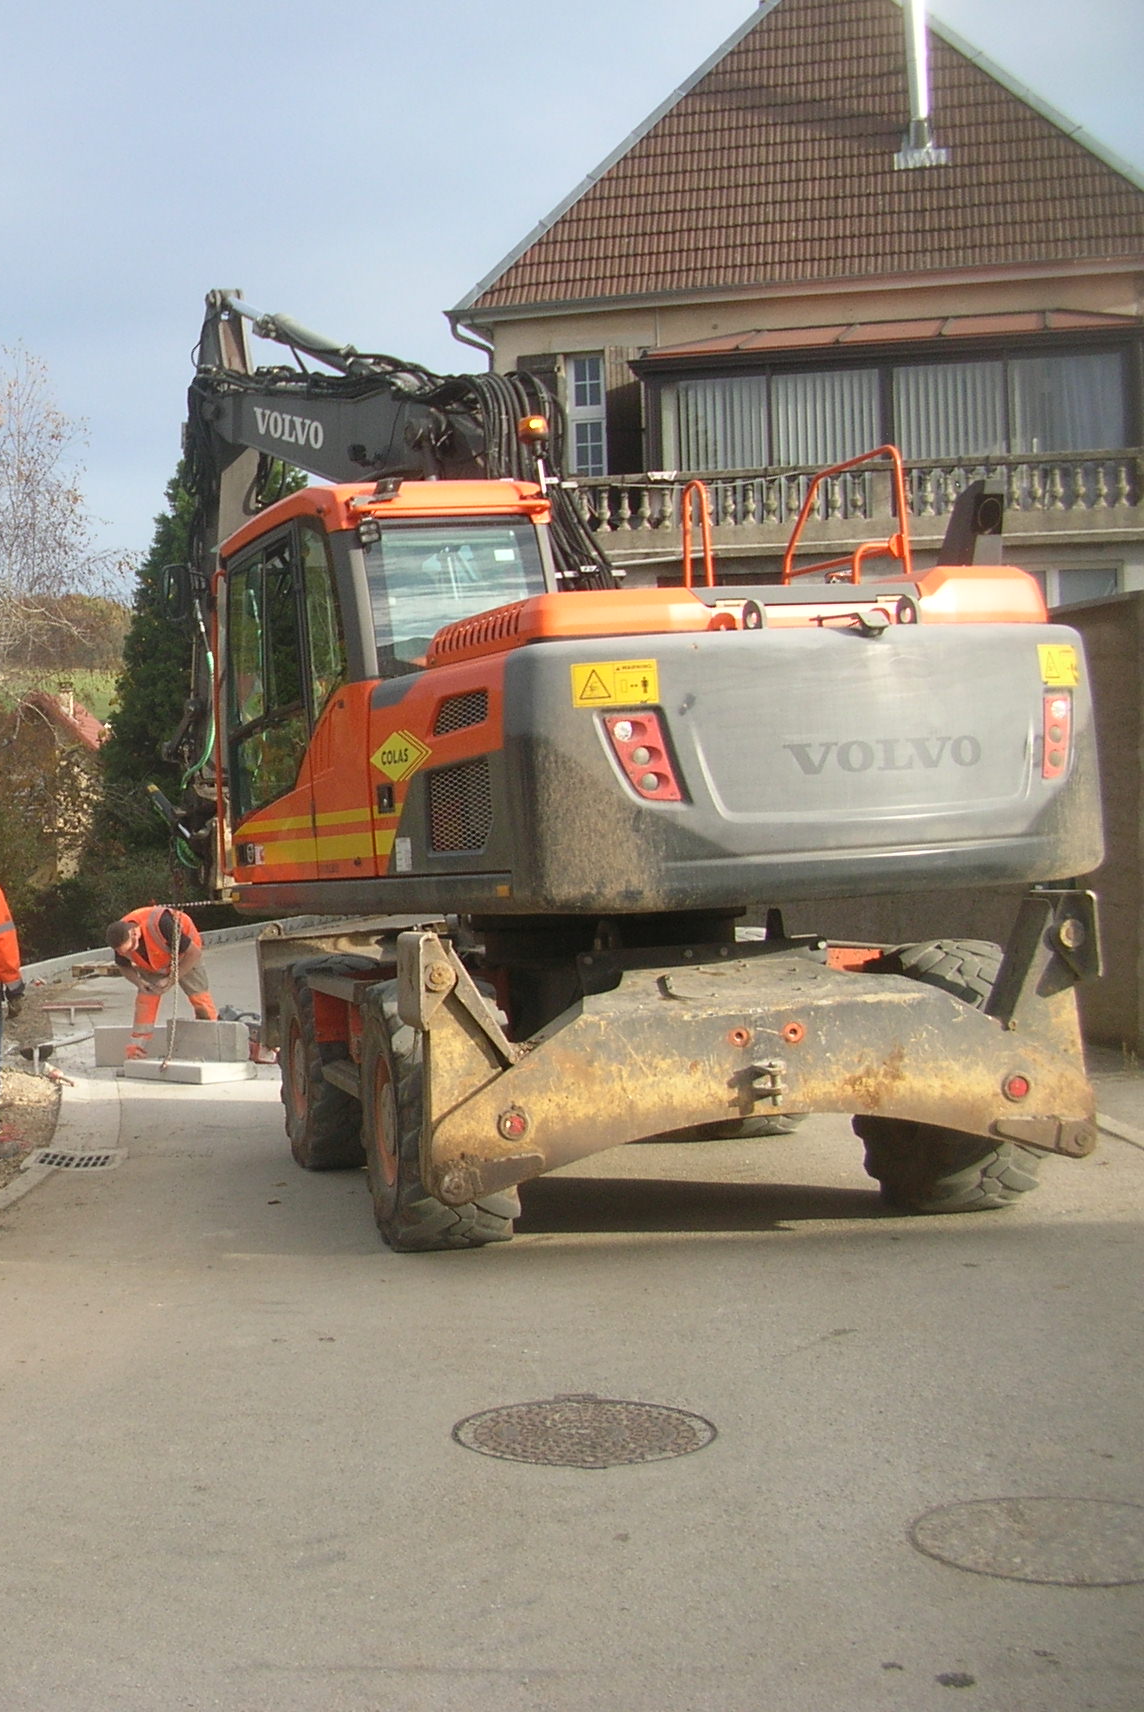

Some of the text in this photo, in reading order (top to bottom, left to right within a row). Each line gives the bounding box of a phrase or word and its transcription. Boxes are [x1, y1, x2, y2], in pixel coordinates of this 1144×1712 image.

[254, 406, 324, 450] VOLVO
[381, 748, 409, 765] COLAS
[782, 735, 982, 776] VOLVO
